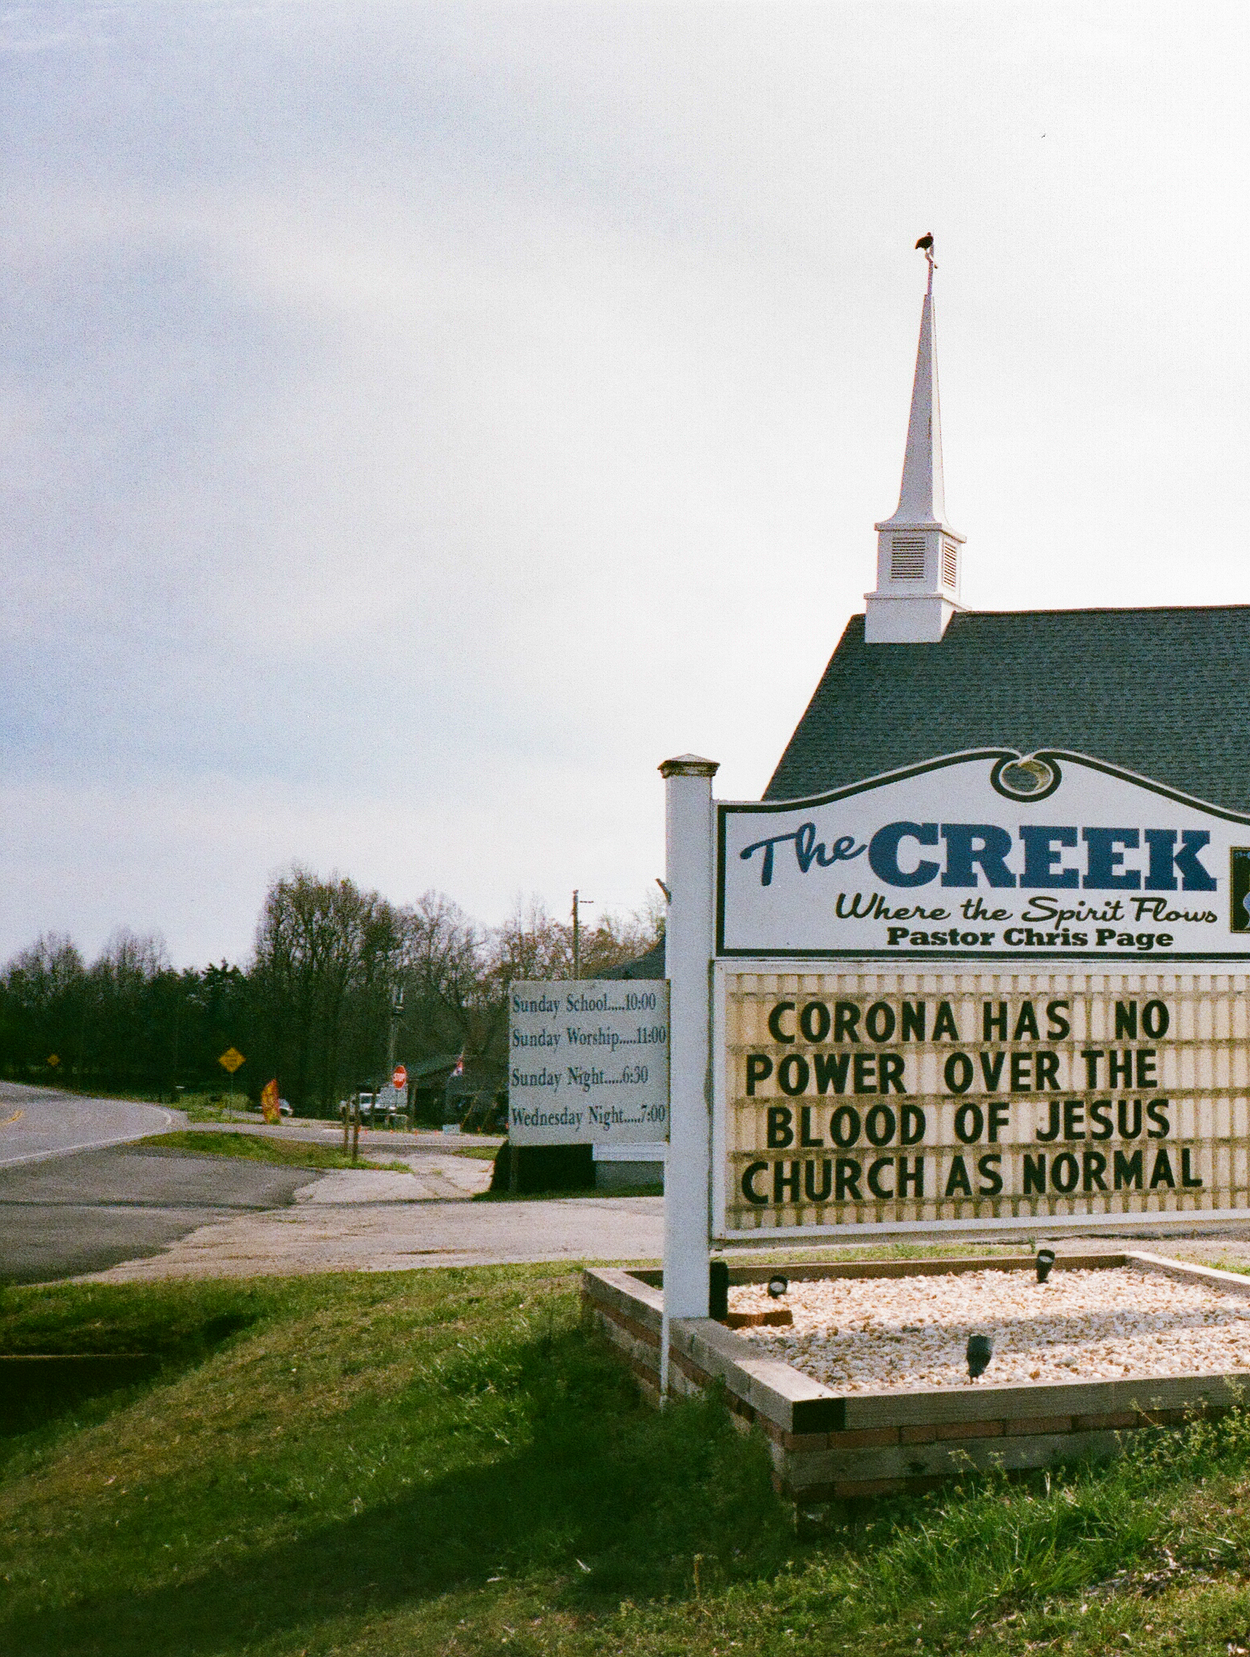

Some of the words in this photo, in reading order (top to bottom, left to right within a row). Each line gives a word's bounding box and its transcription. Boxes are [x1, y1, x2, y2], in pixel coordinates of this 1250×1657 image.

[739, 822, 868, 886] The
[868, 821, 1217, 891] CREEK
[836, 892, 951, 920] Where
[960, 897, 1013, 920] the
[1021, 896, 1124, 930] Spirit
[1130, 897, 1218, 923] Flows
[887, 927, 995, 946] Pastor
[1003, 928, 1088, 947] Chris
[1096, 929, 1174, 950] Page
[512, 994, 560, 1019] Sunday
[768, 1001, 959, 1044] CORONA
[983, 1000, 1071, 1042] HAS
[1115, 1000, 1170, 1040] NO
[512, 1028, 561, 1053] Sunday
[511, 1067, 562, 1092] Sunday
[746, 1053, 907, 1096] POWER
[944, 1051, 1061, 1094] OVER
[1081, 1049, 1158, 1090] THE
[511, 1106, 583, 1131] Wednesday
[767, 1104, 926, 1149] BLOOD
[954, 1102, 1009, 1144] OF
[1036, 1099, 1170, 1142] JESUS
[741, 1156, 924, 1205] CHURCH
[945, 1153, 1004, 1197] AS
[1023, 1148, 1203, 1194] NORMAL
